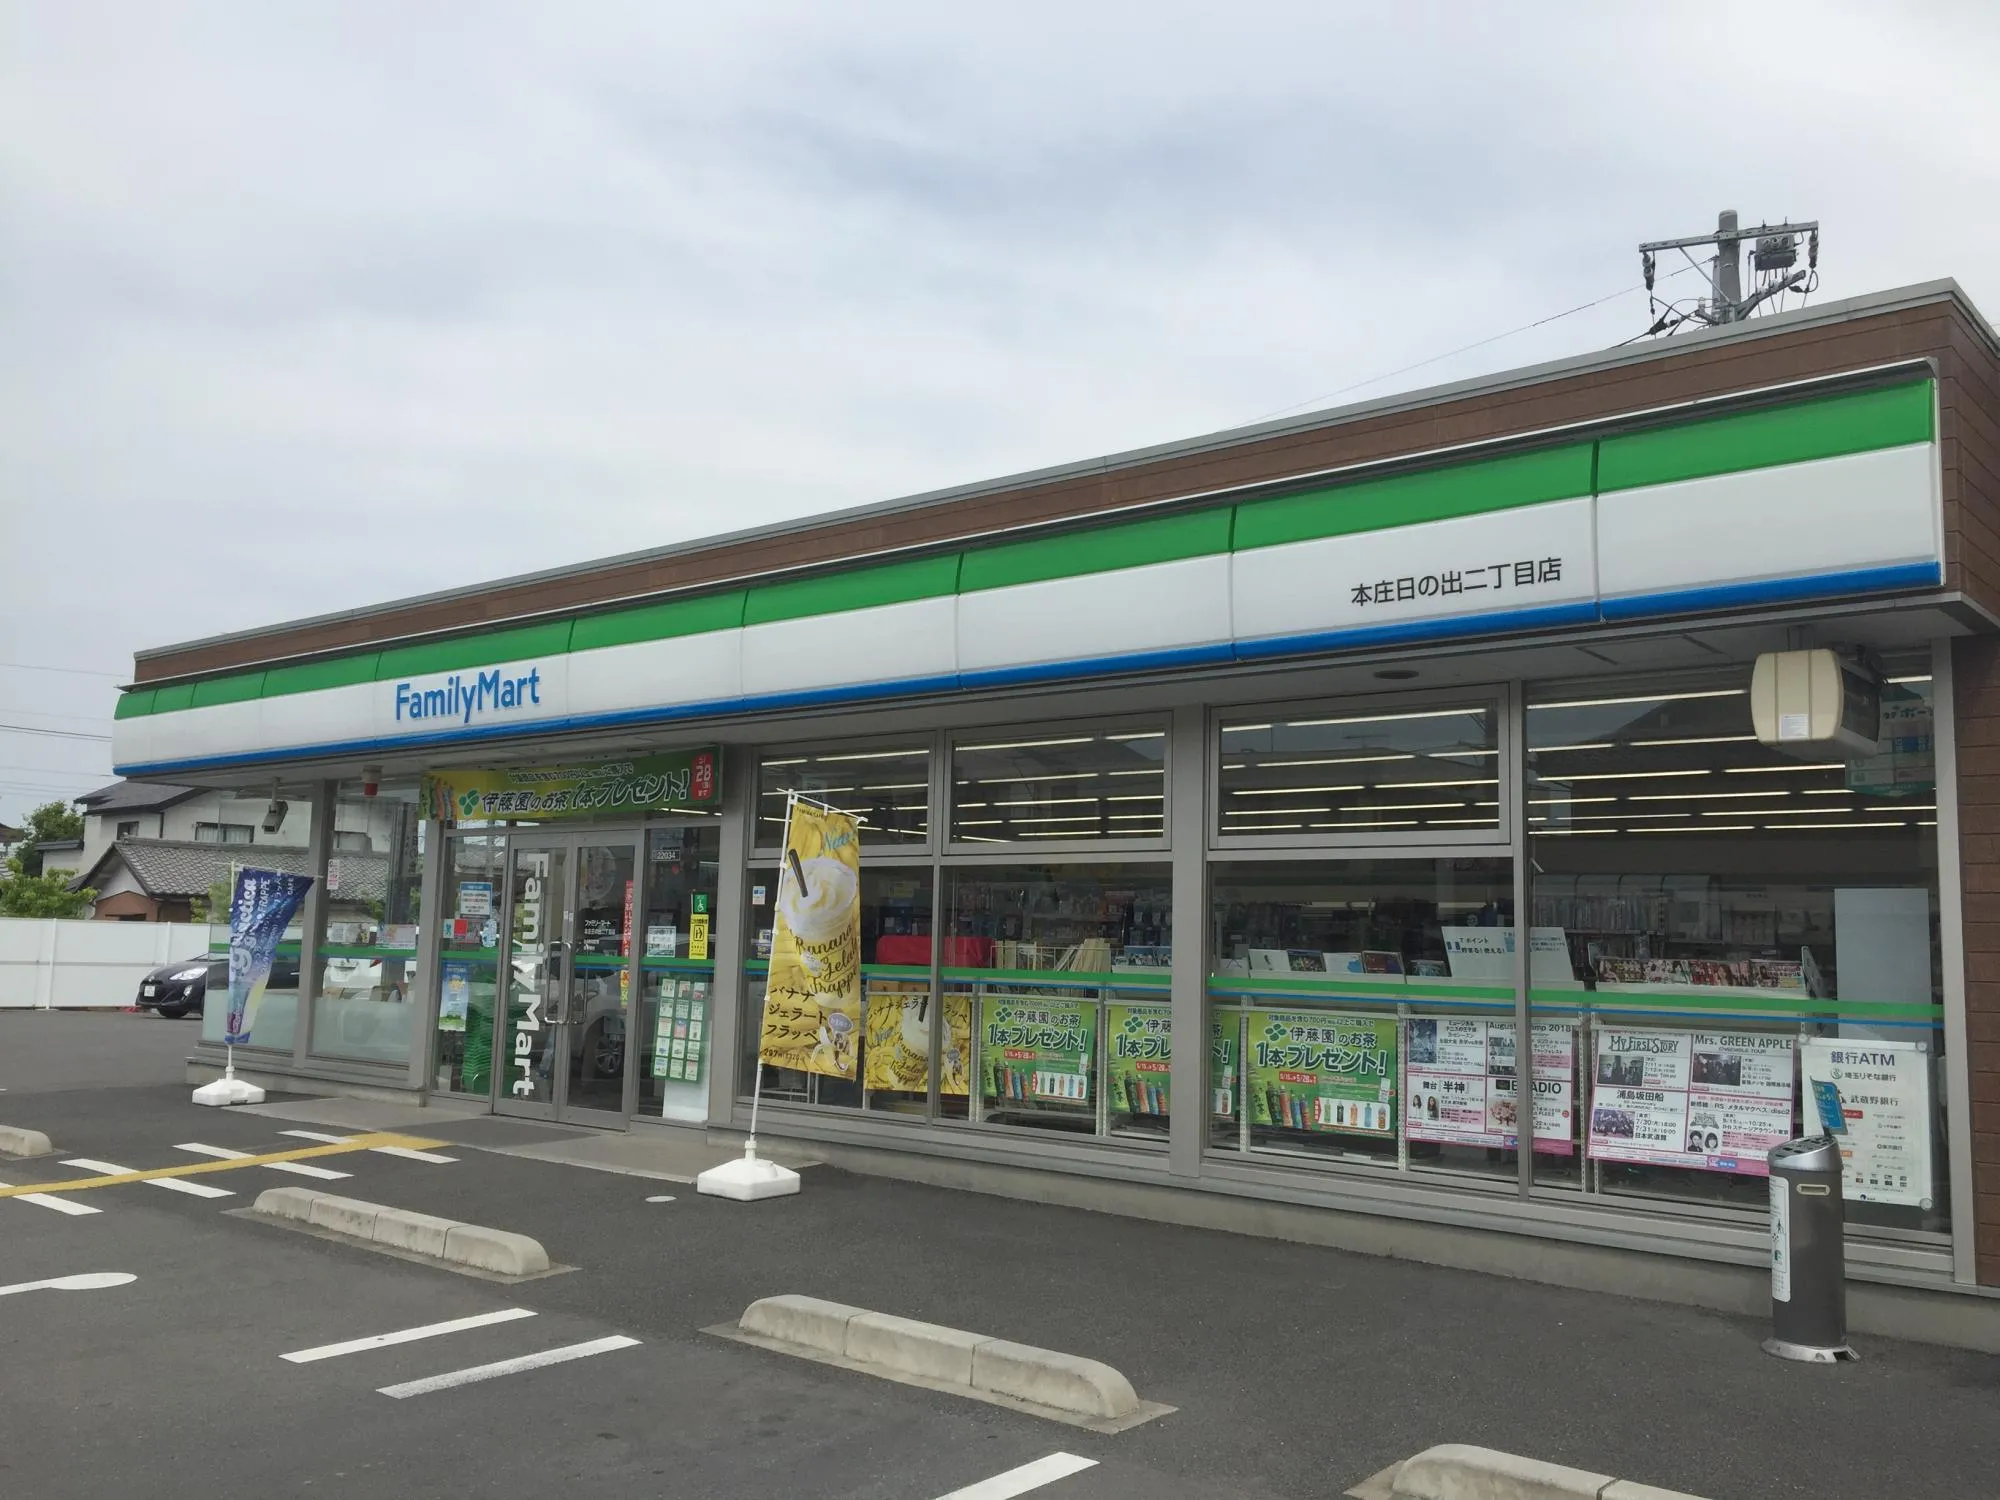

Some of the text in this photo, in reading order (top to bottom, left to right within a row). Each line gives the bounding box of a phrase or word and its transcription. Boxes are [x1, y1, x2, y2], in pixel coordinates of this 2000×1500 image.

[1351, 557, 1562, 607] 本庄日の出二丁目店
[396, 666, 540, 724] FamilyMart
[512, 852, 550, 1096] FamilyMart
[770, 985, 816, 1003] バナナ
[768, 1002, 828, 1025] ジェラート
[1013, 1009, 1082, 1028] 伊藤園のお茶
[765, 1024, 822, 1044] フラッペ
[988, 1023, 1088, 1052] 1本プレゼント!
[1289, 1026, 1377, 1049] 伊藤園のお茶
[1548, 1024, 1571, 1033] 2018
[1694, 1034, 1793, 1050] Mrs. GREEN APPLE
[1256, 1041, 1387, 1075] 1本プレゼント!
[1831, 1051, 1896, 1066] 銀行ATM
[1844, 1072, 1897, 1082] 埼玉りそな銀行
[1850, 1095, 1900, 1106] 武蔵野銀行
